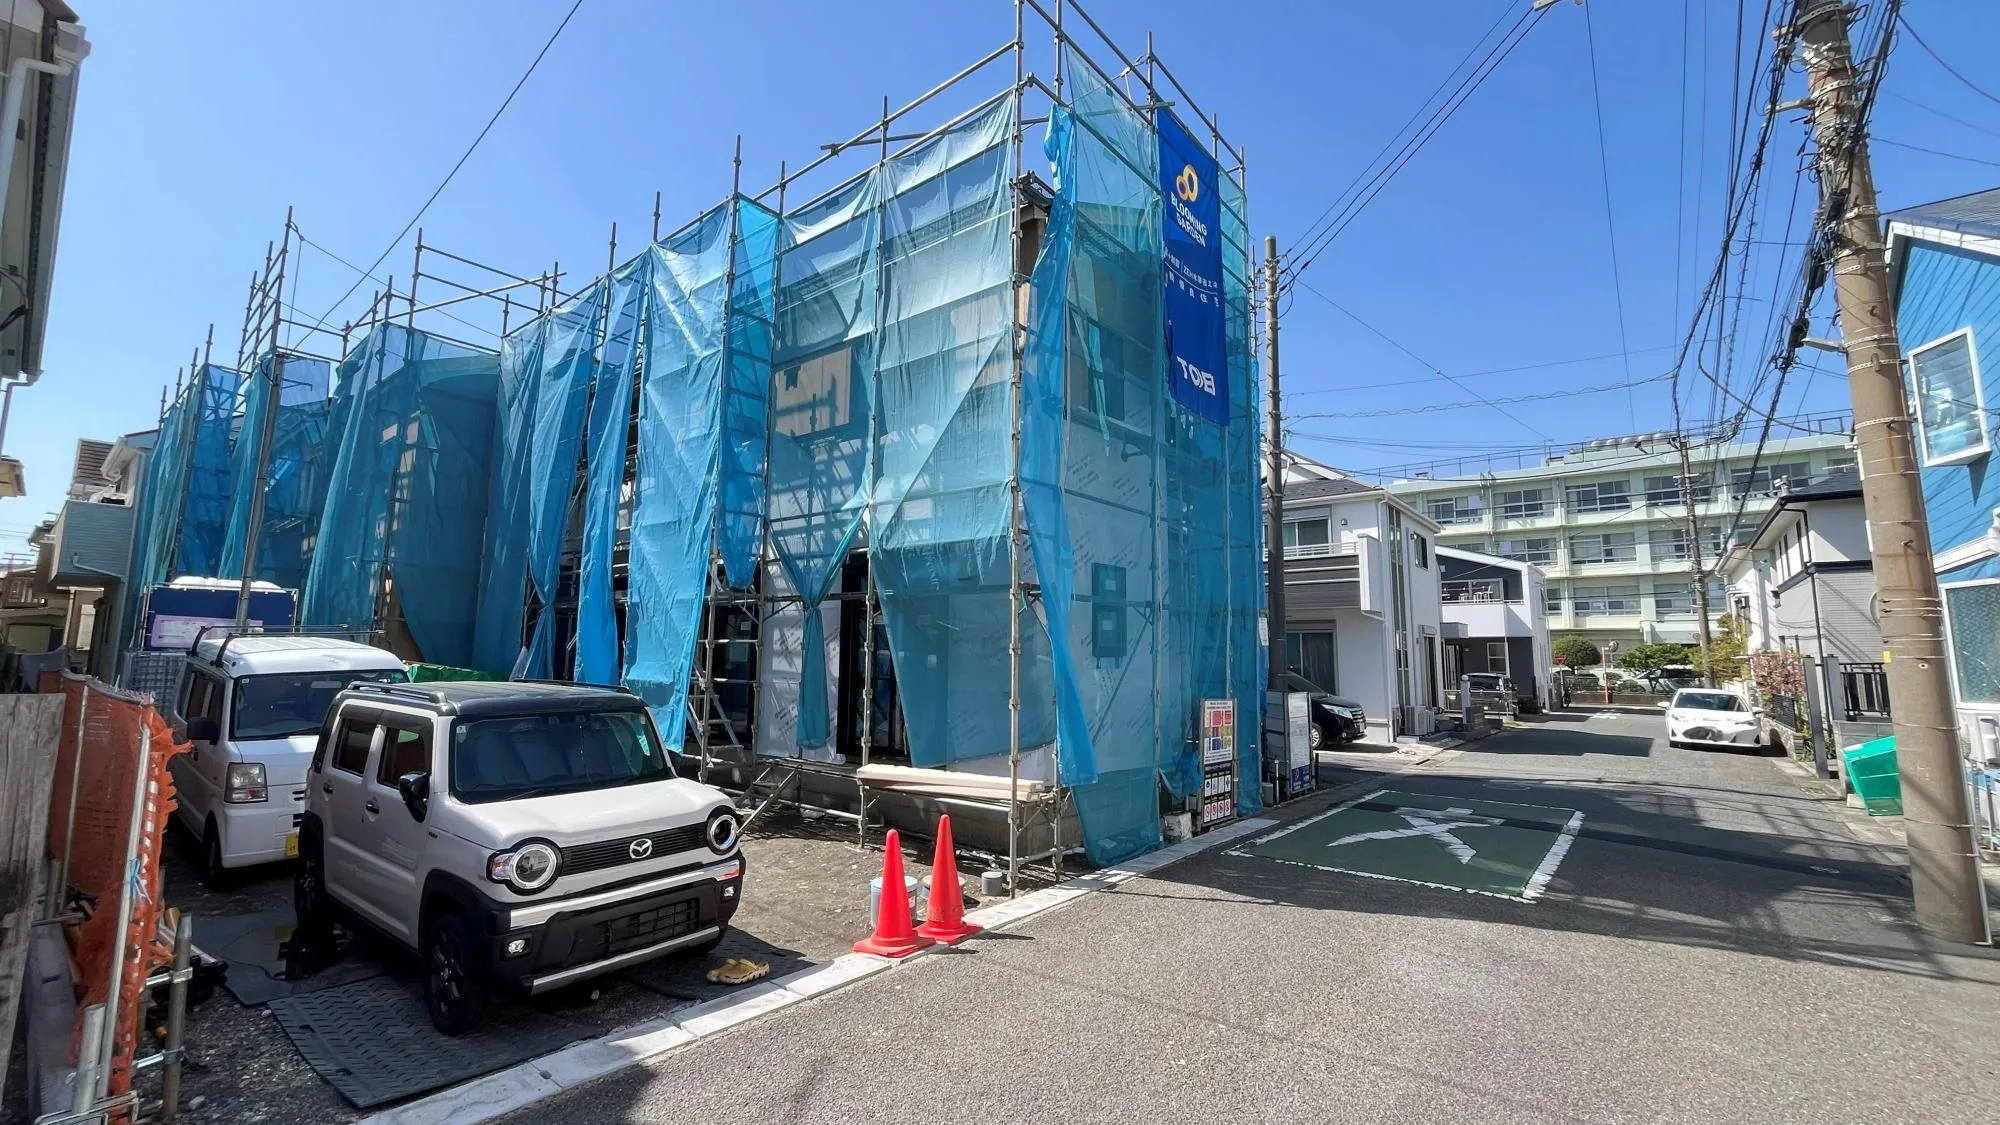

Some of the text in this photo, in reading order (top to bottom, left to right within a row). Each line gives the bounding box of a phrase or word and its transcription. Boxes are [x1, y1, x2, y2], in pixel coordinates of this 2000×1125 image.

[1171, 191, 1208, 236] BLOOMING
[1176, 211, 1206, 248] GARDEN
[1326, 807, 1505, 865] 文
